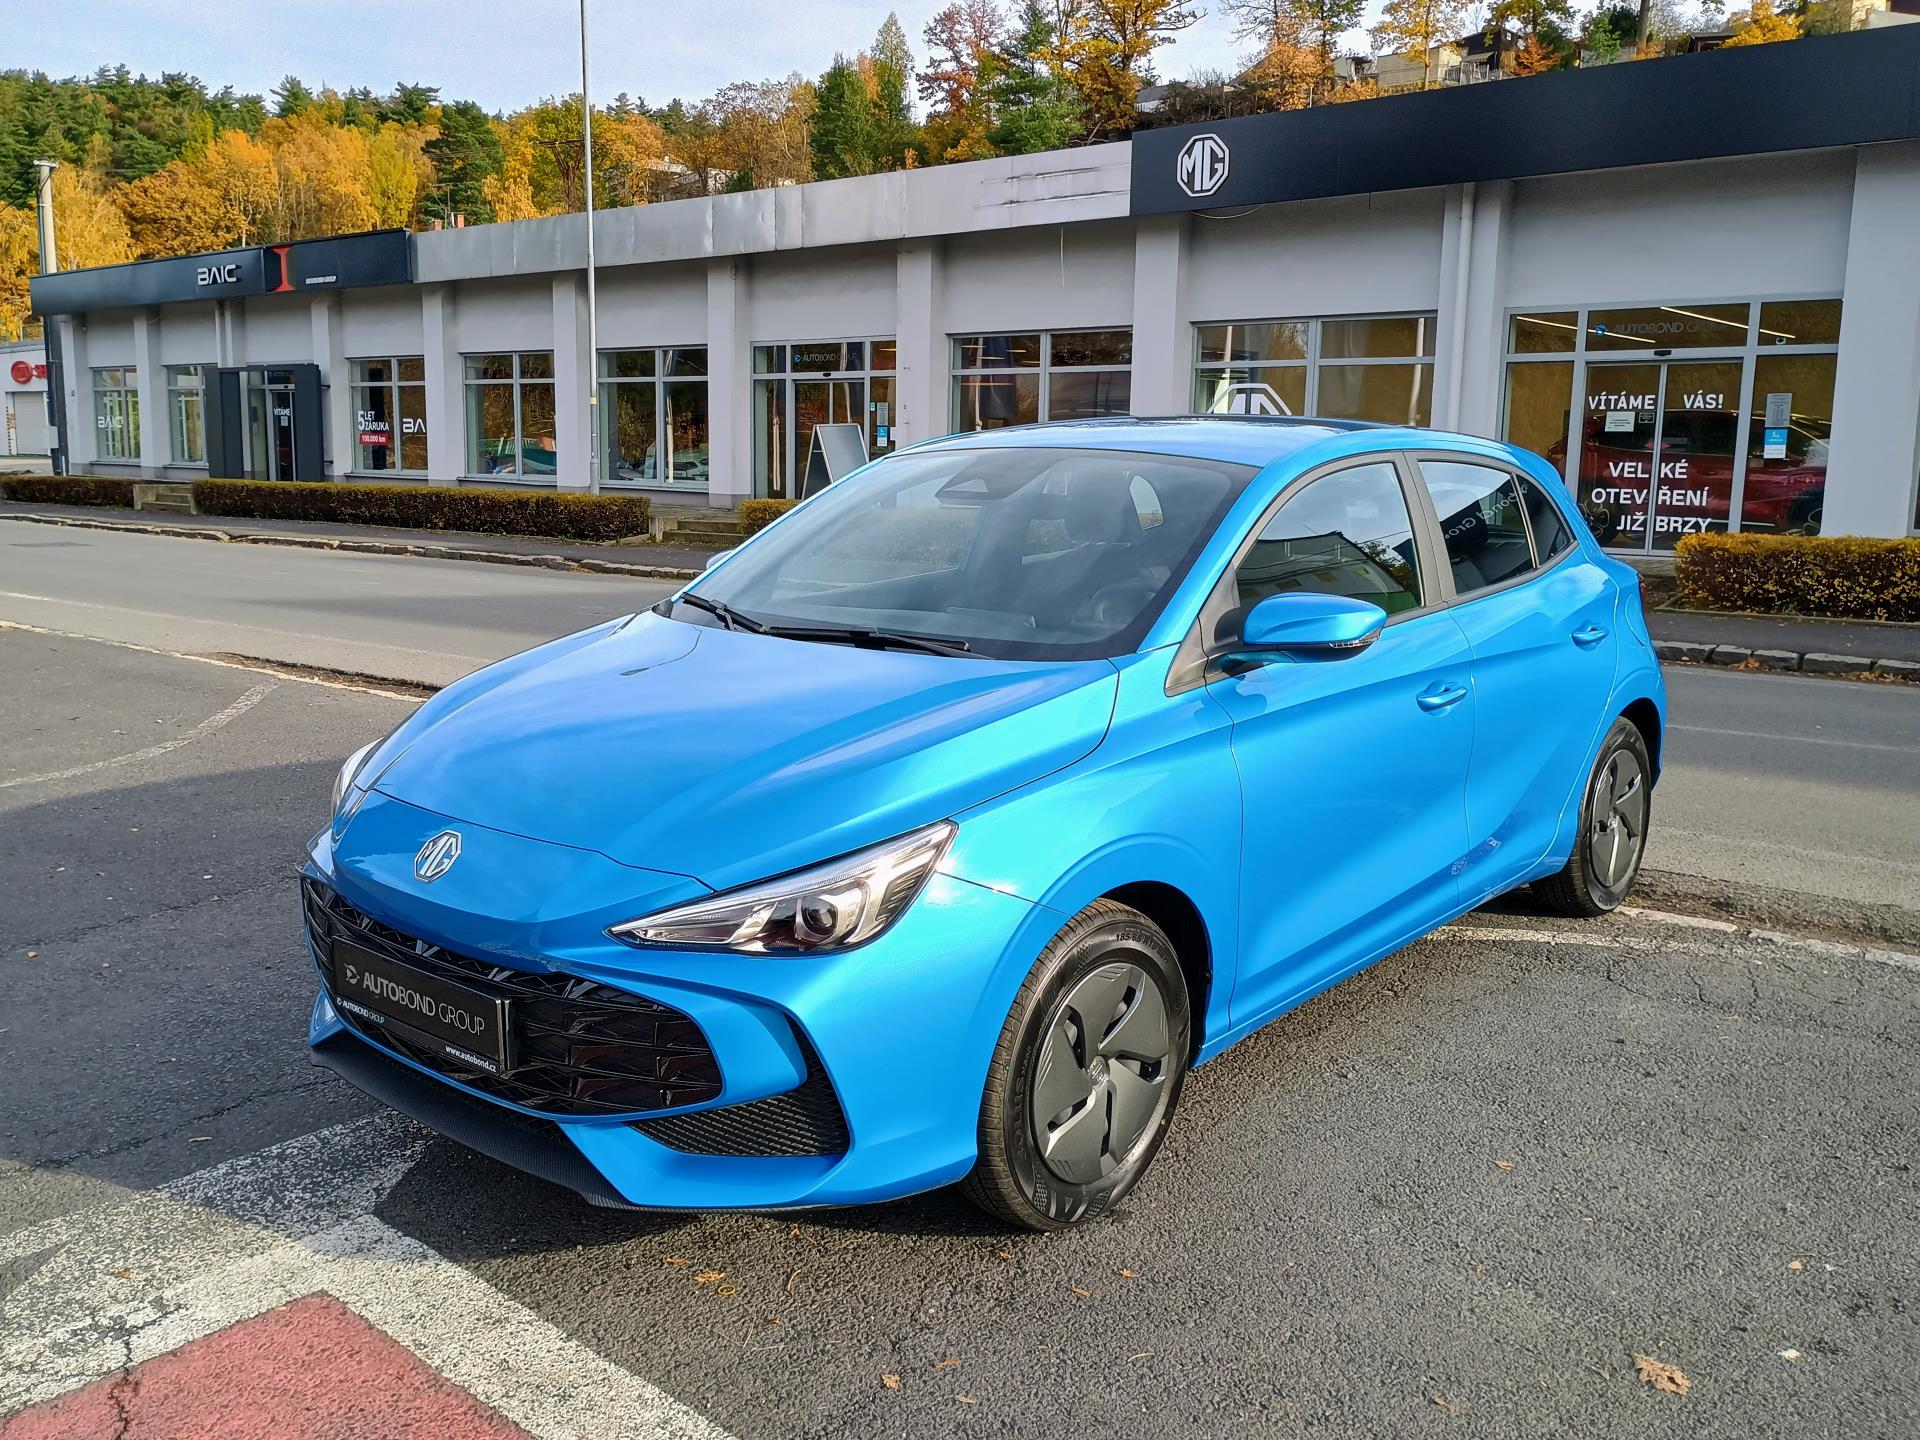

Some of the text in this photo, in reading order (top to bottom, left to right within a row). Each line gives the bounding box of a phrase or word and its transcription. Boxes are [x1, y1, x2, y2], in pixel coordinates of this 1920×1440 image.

[1181, 139, 1225, 192] MG
[197, 264, 237, 286] BAIC
[802, 353, 836, 362] AUTOBOND
[1588, 390, 1724, 410] VÍTÁME VÁS!
[357, 410, 375, 431] 5 LET
[364, 419, 390, 431] ZÁRUKA
[1616, 511, 1712, 533] JIŽ BRZY
[417, 834, 457, 878] MG
[342, 1000, 385, 1025] AUTOBOND GROUP
[362, 971, 485, 1036] AUTOBOND GROUP
[445, 1045, 497, 1073] www.autobond.cz
